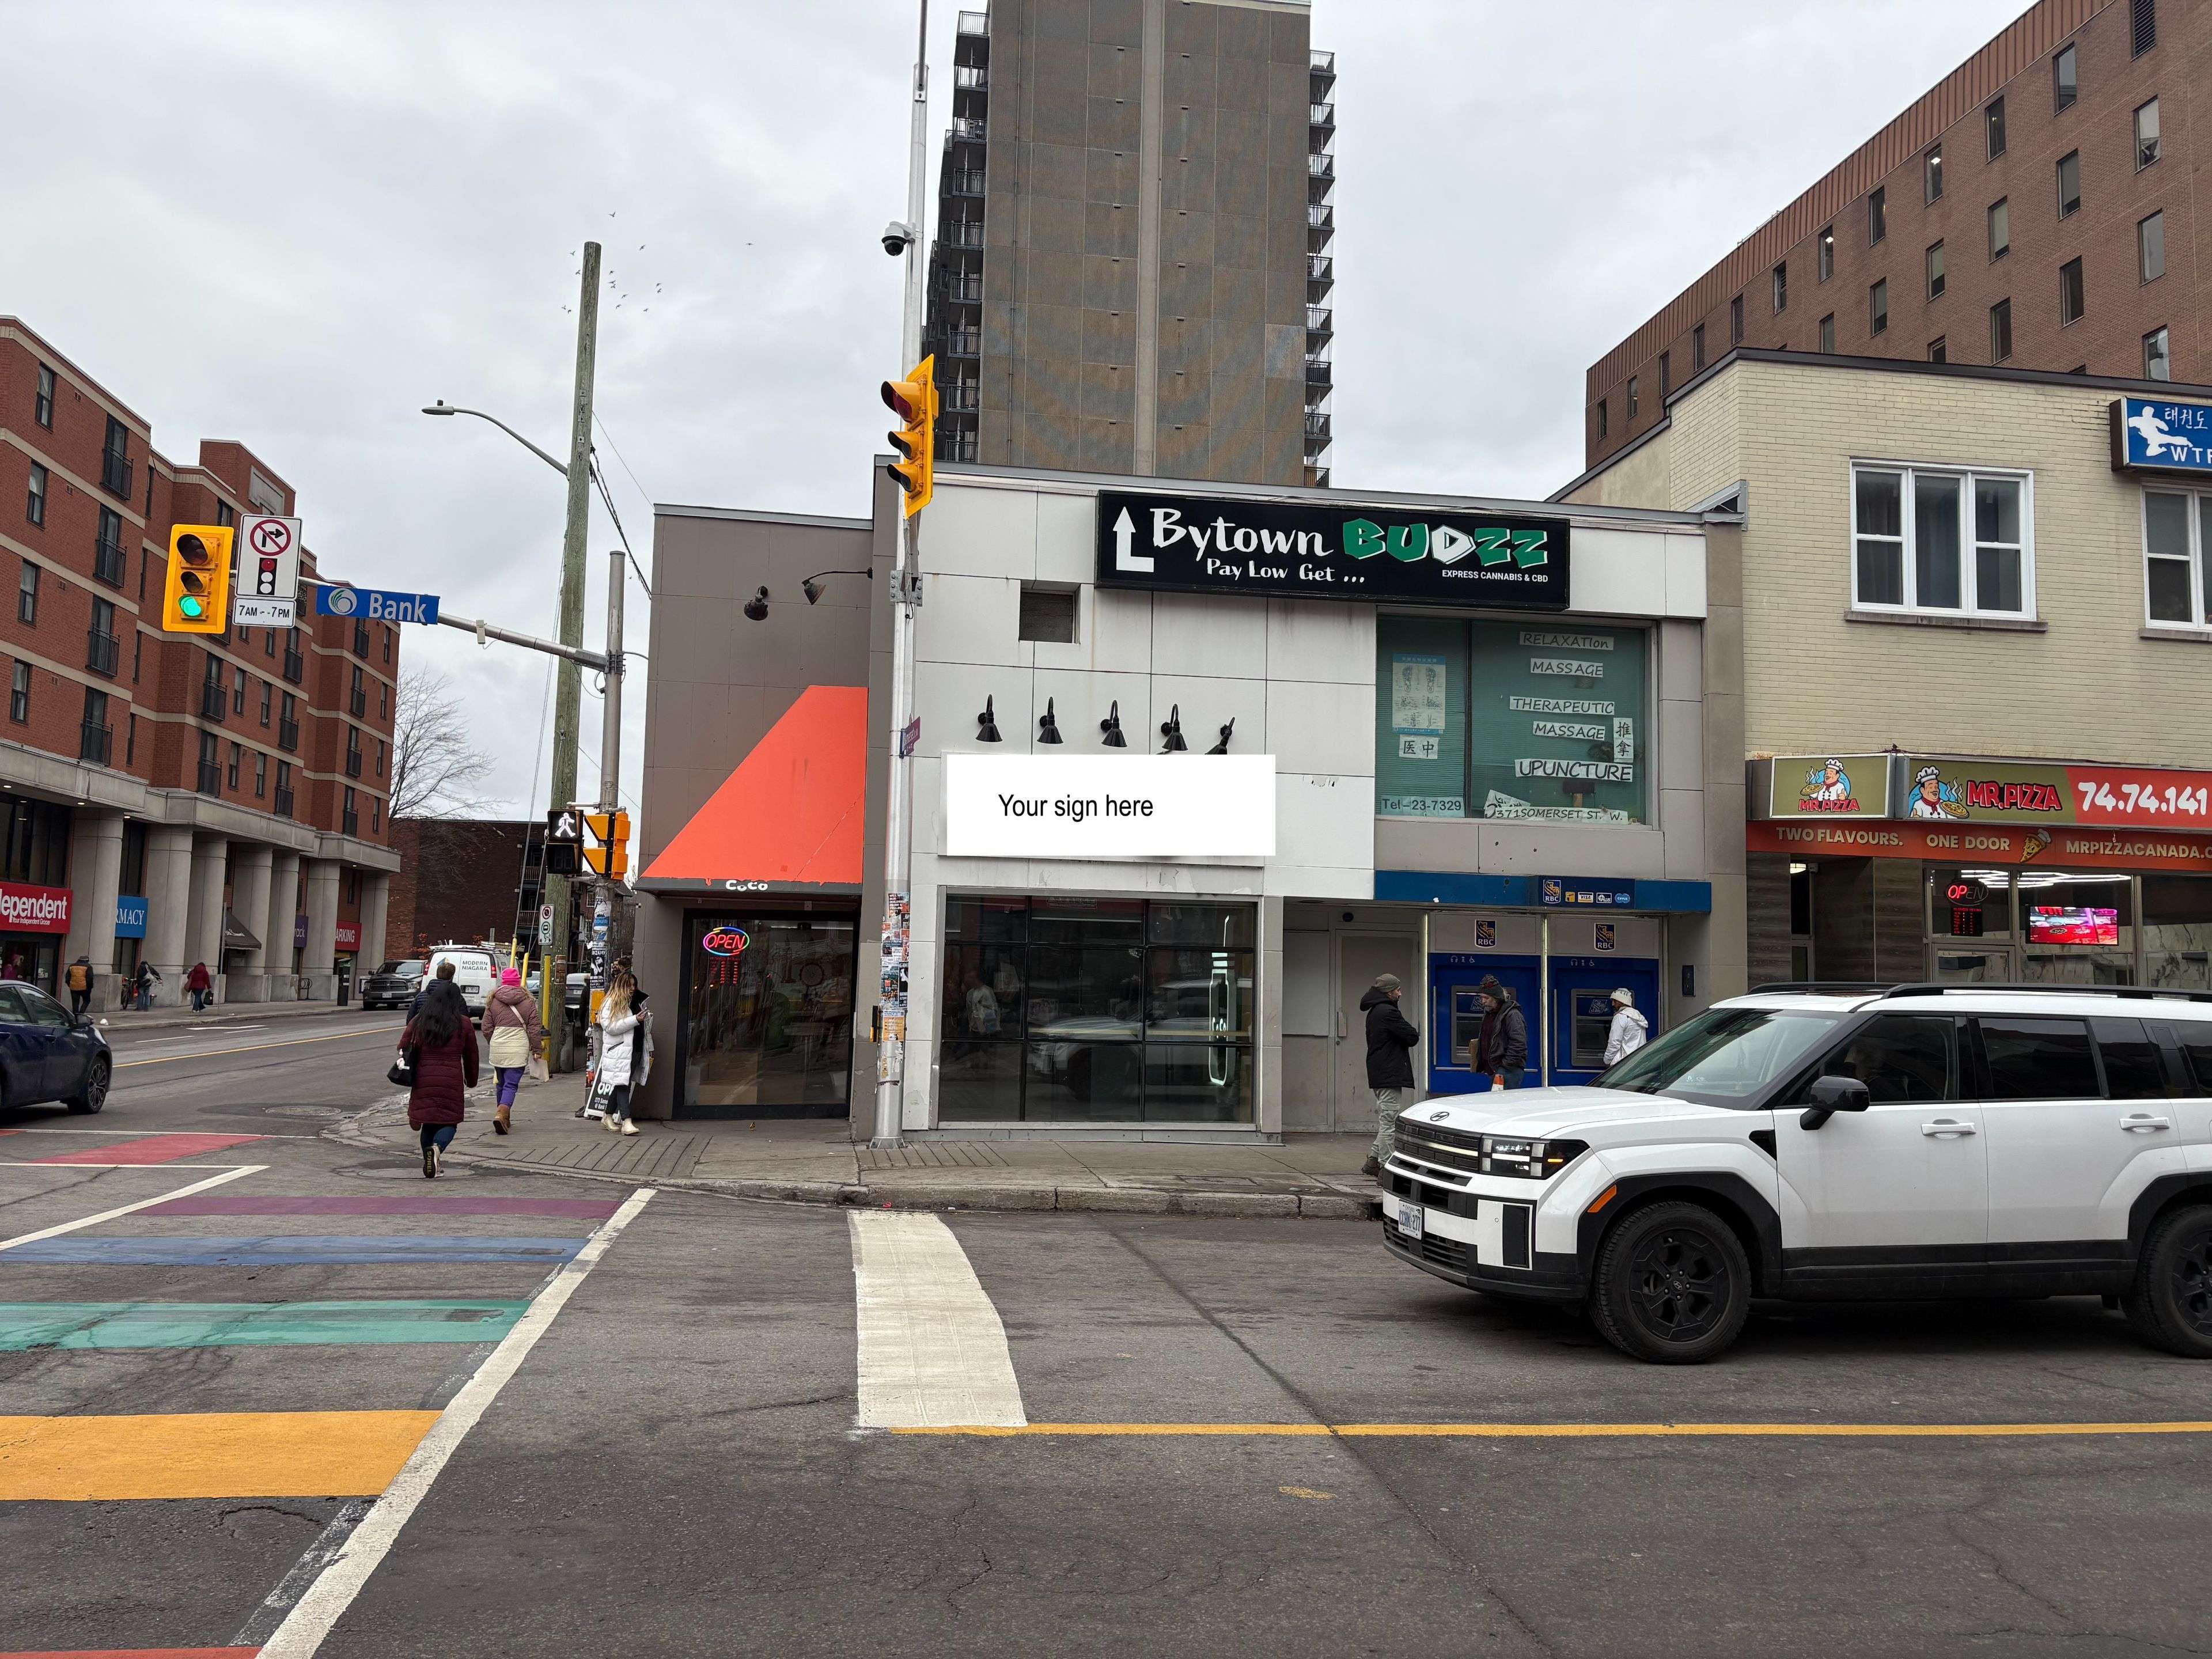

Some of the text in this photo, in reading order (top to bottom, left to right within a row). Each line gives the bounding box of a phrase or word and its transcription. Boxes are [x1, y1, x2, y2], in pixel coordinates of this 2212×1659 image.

[2164, 407, 2208, 429] 태권도
[1150, 508, 1548, 569] Bytown BUDZZ
[1207, 558, 1242, 581] Pay
[1249, 560, 1288, 578] Low
[1299, 563, 1335, 581] Get
[1442, 569, 1548, 582] EXPRESS CANNABIS & CBD
[369, 593, 426, 622] Bank
[1532, 661, 1603, 676] MASSAGE
[1513, 698, 1614, 714] THERAPEUTIC
[1535, 723, 1605, 739] MASSAGE
[1616, 721, 1632, 757] 推拿
[1520, 760, 1633, 781] UPUNCTURE
[2078, 782, 2207, 816] 74.74.141
[1587, 810, 1602, 819] ST.
[1610, 812, 1623, 821] W.
[1777, 827, 1903, 846] TWO FLAVOURS.
[1926, 834, 2010, 851] ONE DOOR
[1948, 885, 1984, 899] OPEN
[706, 934, 745, 949] OPEN
